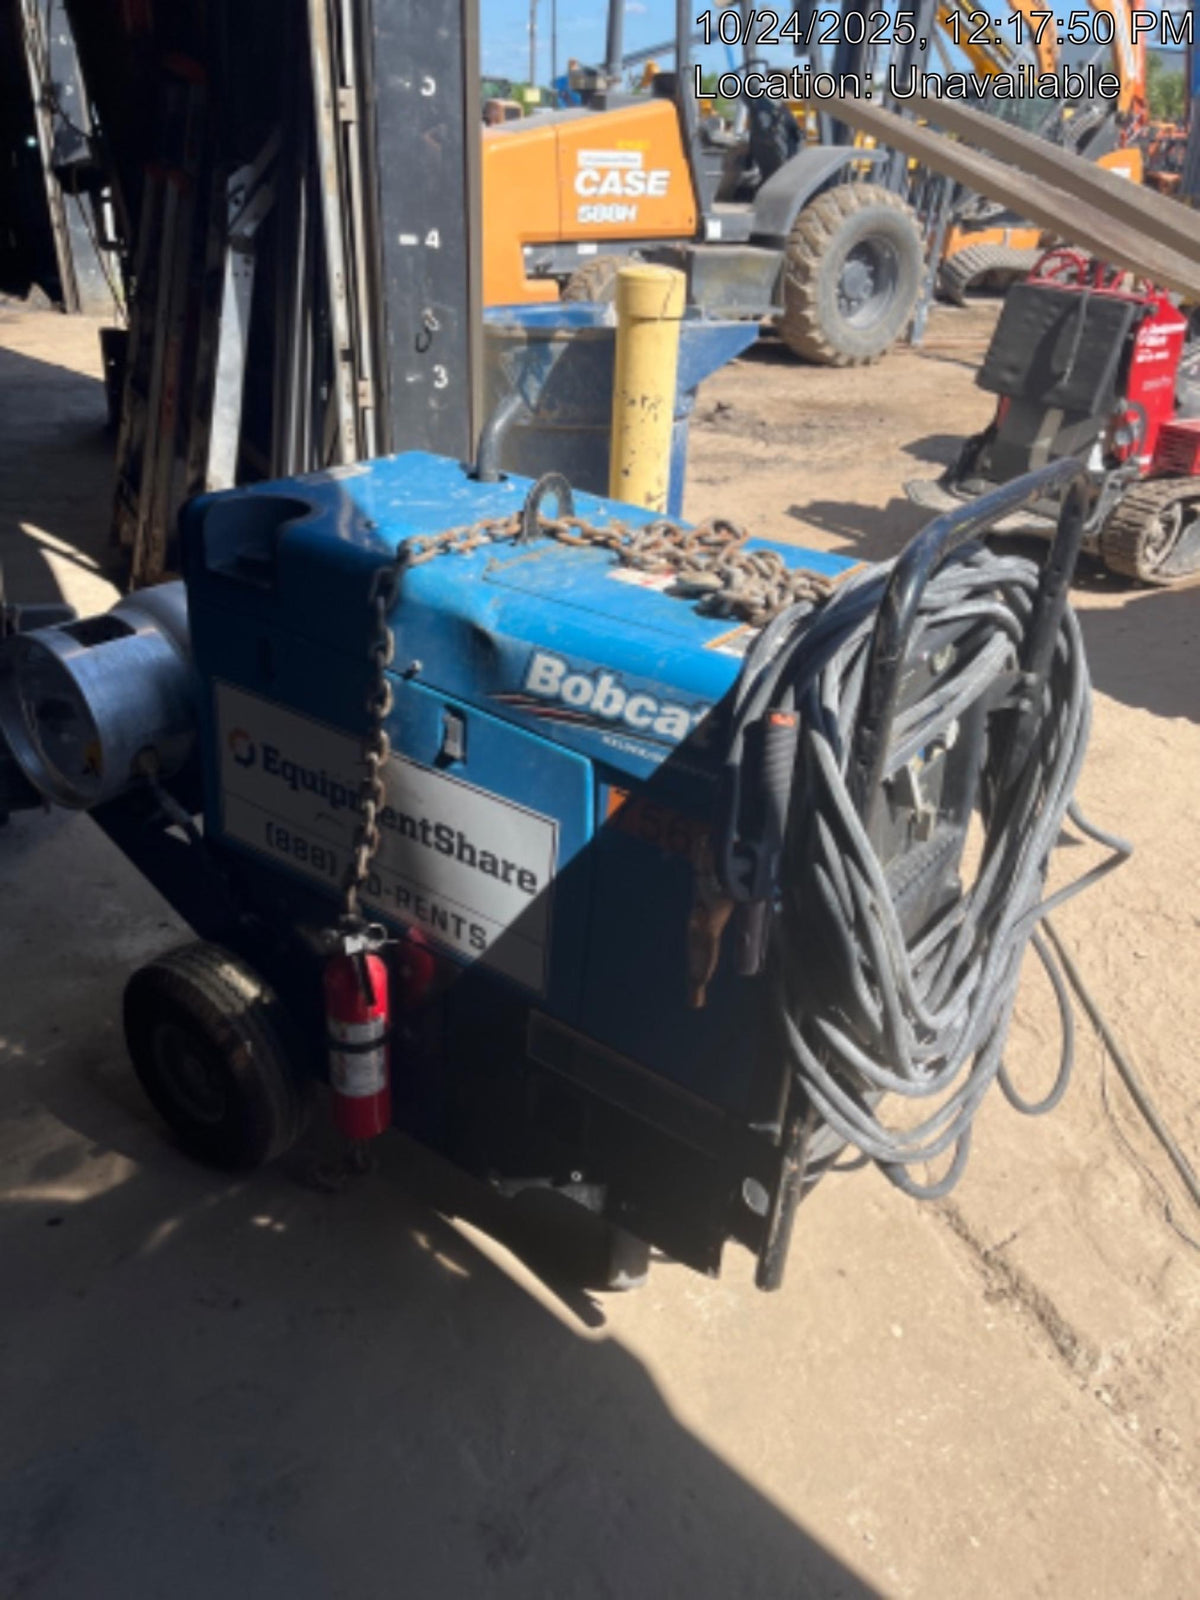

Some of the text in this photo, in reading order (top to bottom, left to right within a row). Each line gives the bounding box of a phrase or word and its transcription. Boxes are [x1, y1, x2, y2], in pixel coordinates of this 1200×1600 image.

[574, 168, 671, 198] CASE
[424, 227, 441, 249] 4
[433, 364, 449, 390] 3
[265, 822, 337, 877] (888)
